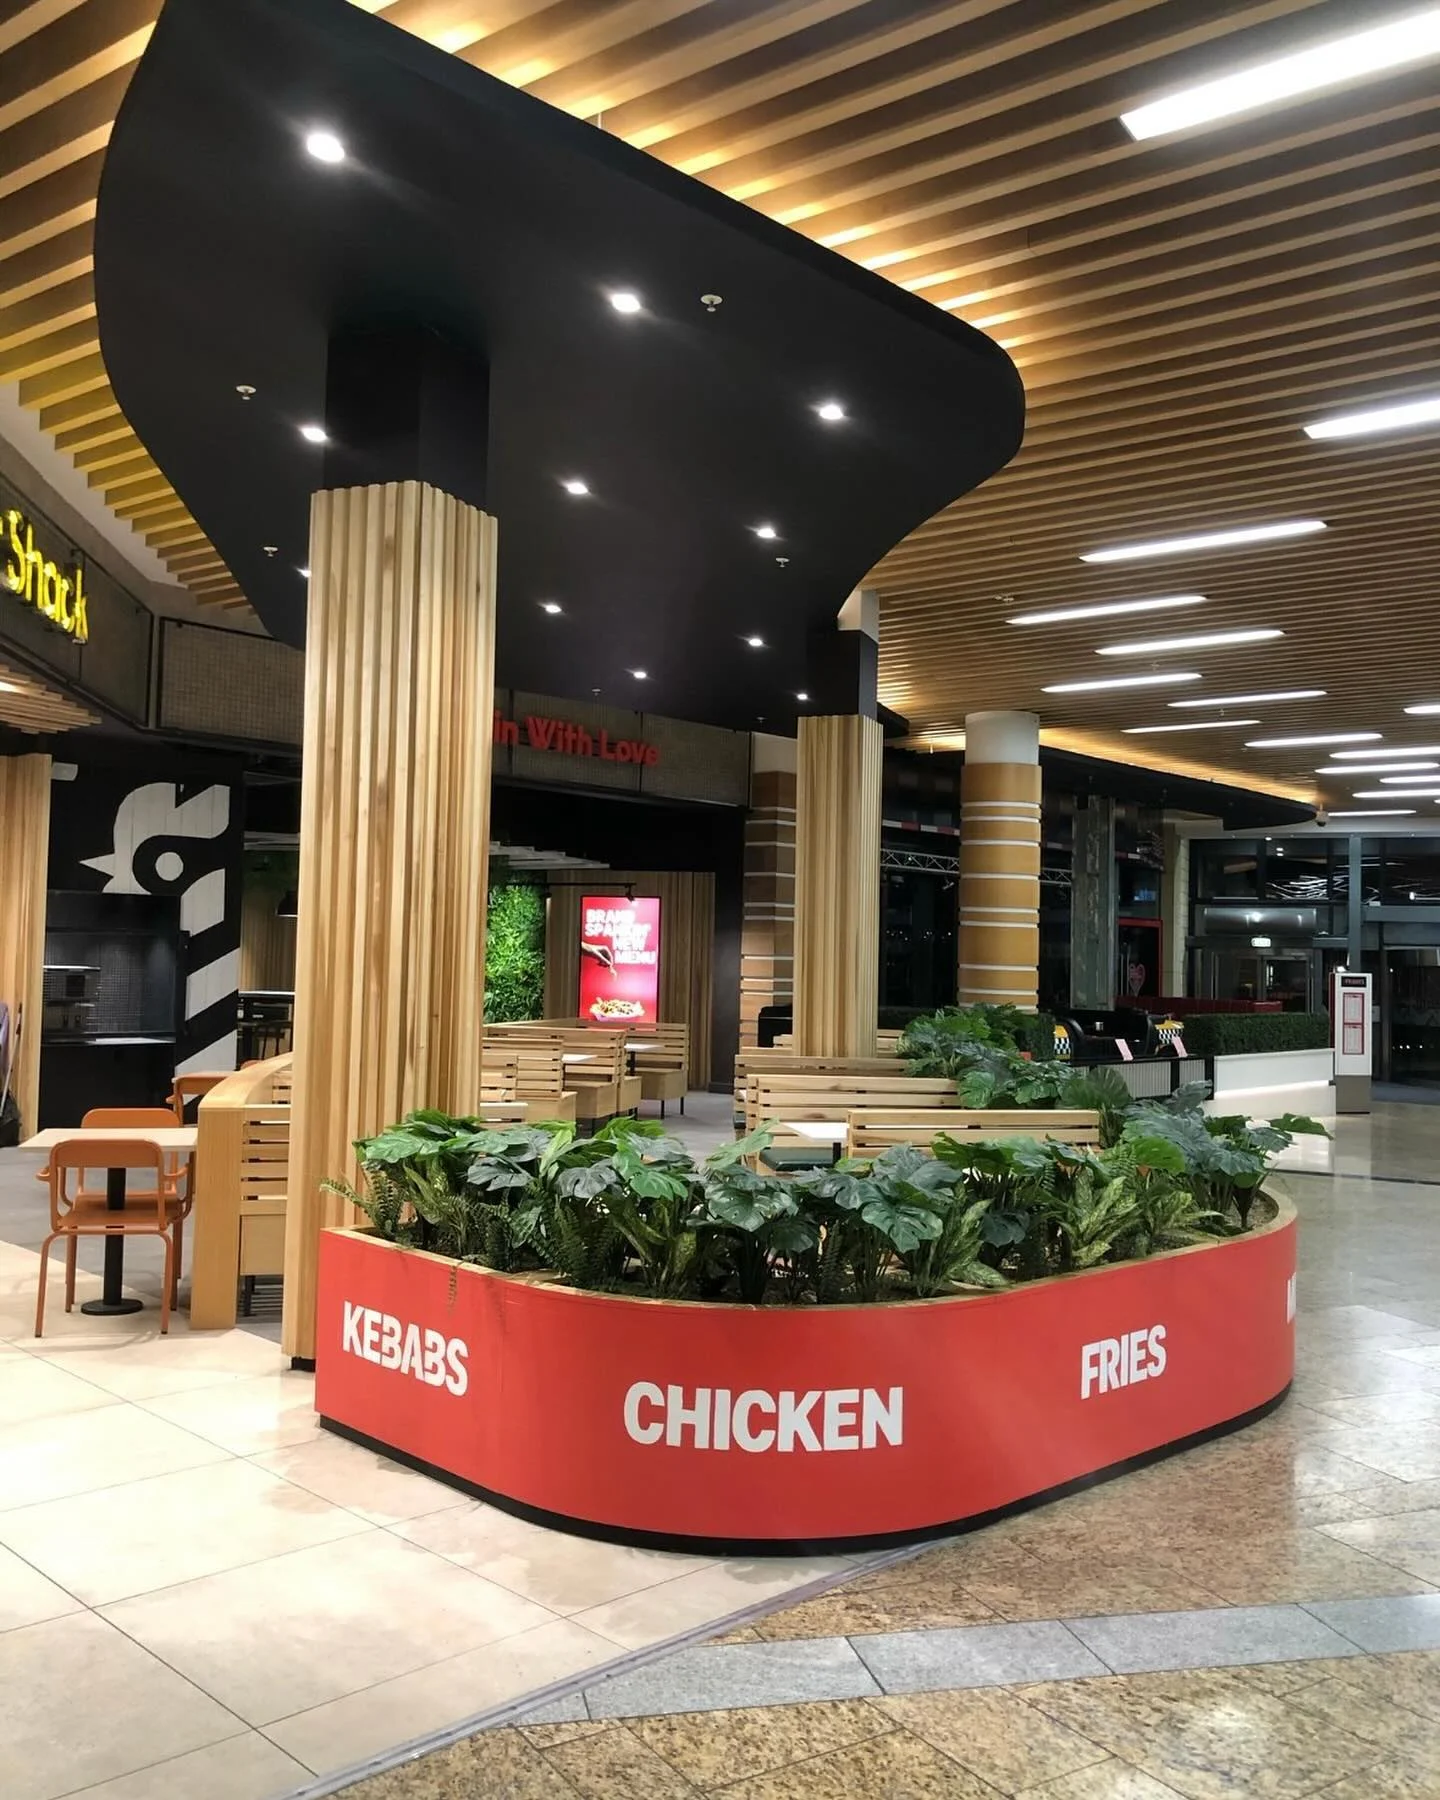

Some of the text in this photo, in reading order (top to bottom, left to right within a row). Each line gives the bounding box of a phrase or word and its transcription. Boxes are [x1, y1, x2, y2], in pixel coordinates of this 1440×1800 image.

[7, 510, 88, 640] Shack
[525, 716, 593, 757] With
[599, 729, 659, 766] Love
[343, 1300, 469, 1396] KEBABS
[1081, 1324, 1167, 1400] FRIES
[624, 1381, 903, 1453] CHICKEN
